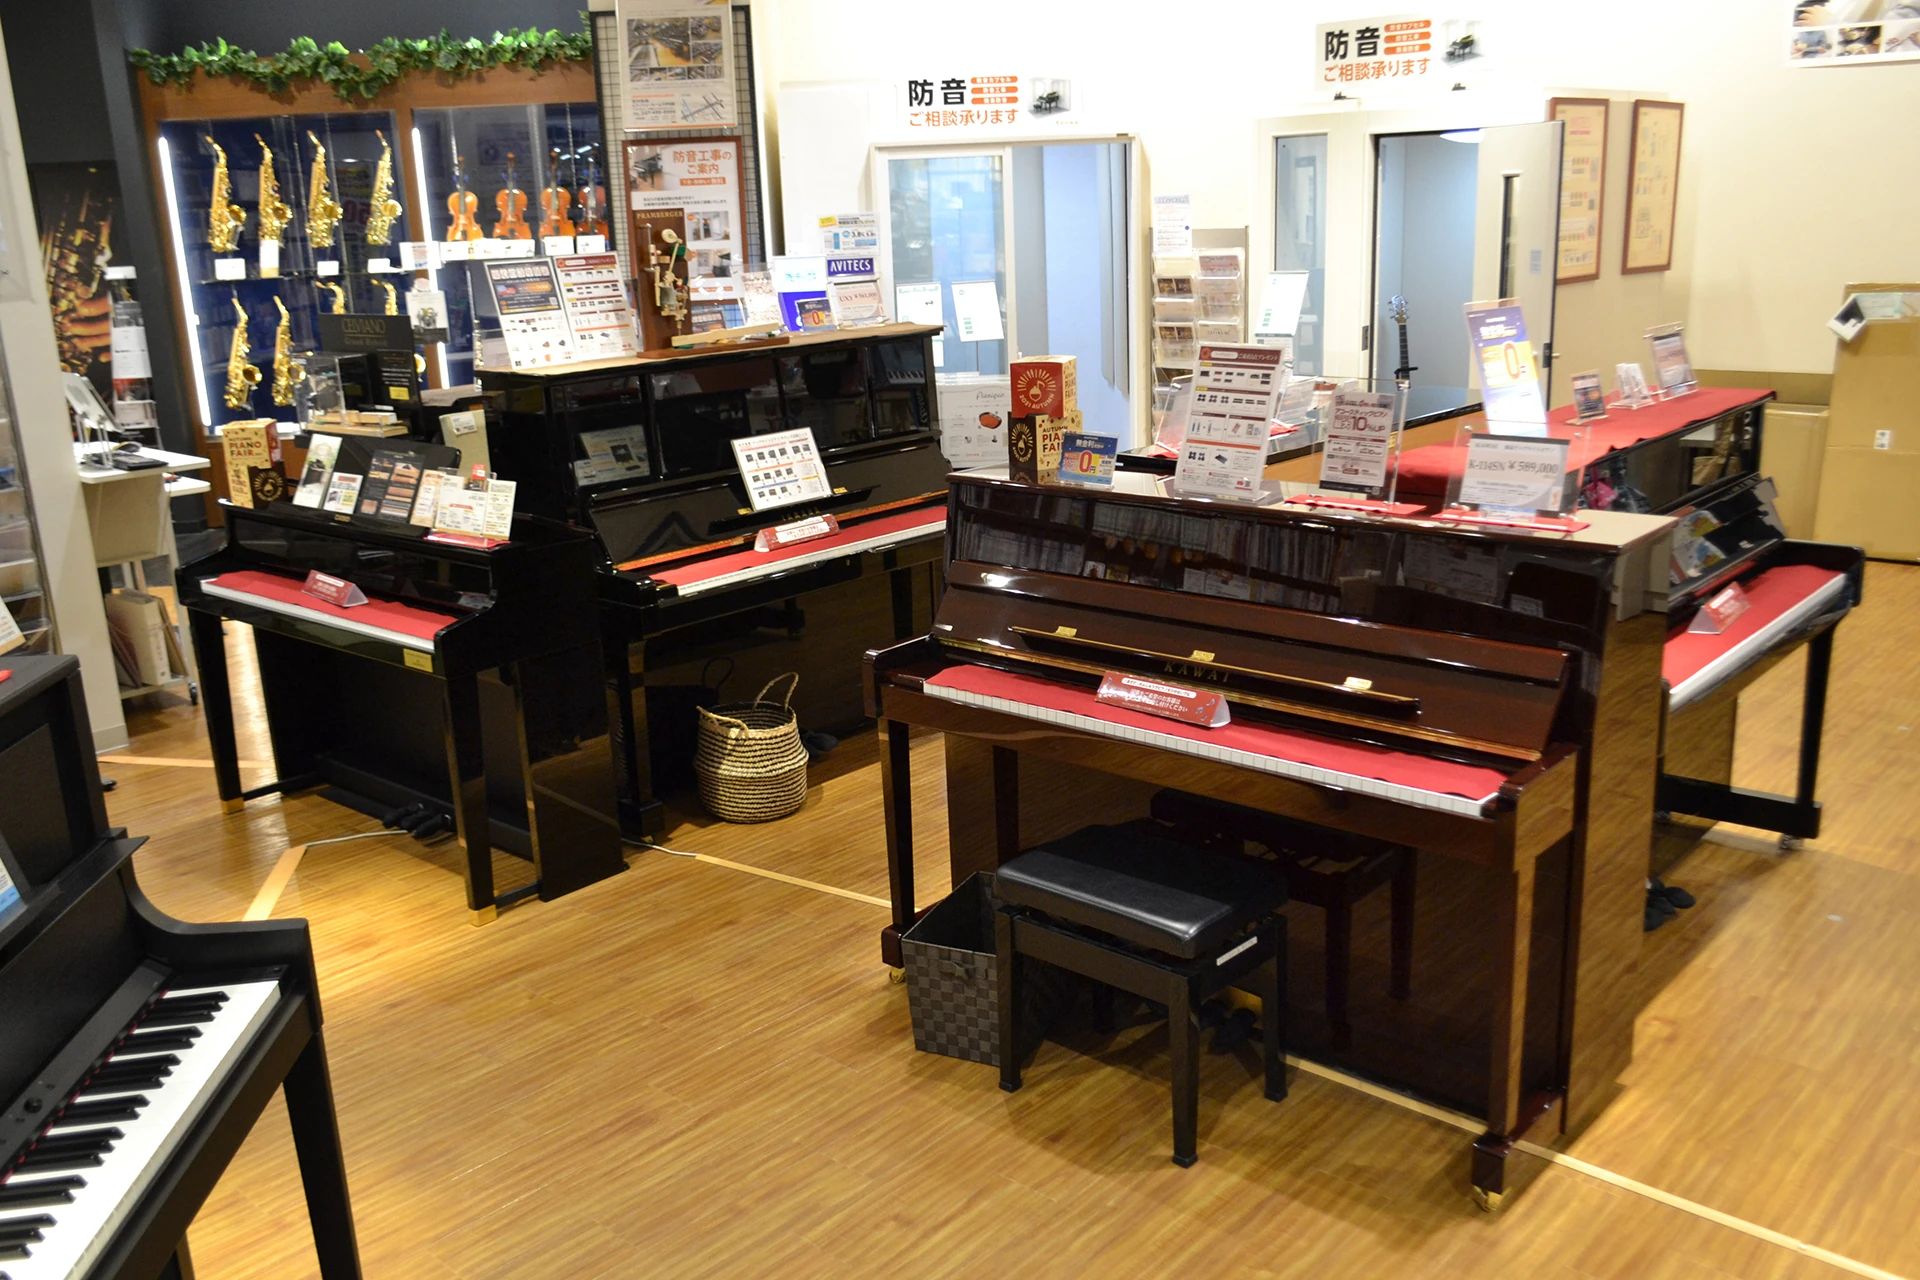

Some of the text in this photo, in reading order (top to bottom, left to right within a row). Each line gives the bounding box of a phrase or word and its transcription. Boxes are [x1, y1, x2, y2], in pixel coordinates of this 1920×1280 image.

[1325, 26, 1380, 61] 防音
[1324, 57, 1430, 82] ご相談承ります
[908, 78, 967, 107] 防音
[909, 109, 1019, 127] ご相談承ります
[673, 149, 733, 164] 防音工事の
[687, 162, 720, 175] ご案内
[636, 210, 684, 221] PRAMBERGER
[830, 259, 871, 273] AVITECS
[229, 441, 262, 449] PIANO
[230, 449, 255, 457] FAIR
[1164, 662, 1229, 682] KAWAI
